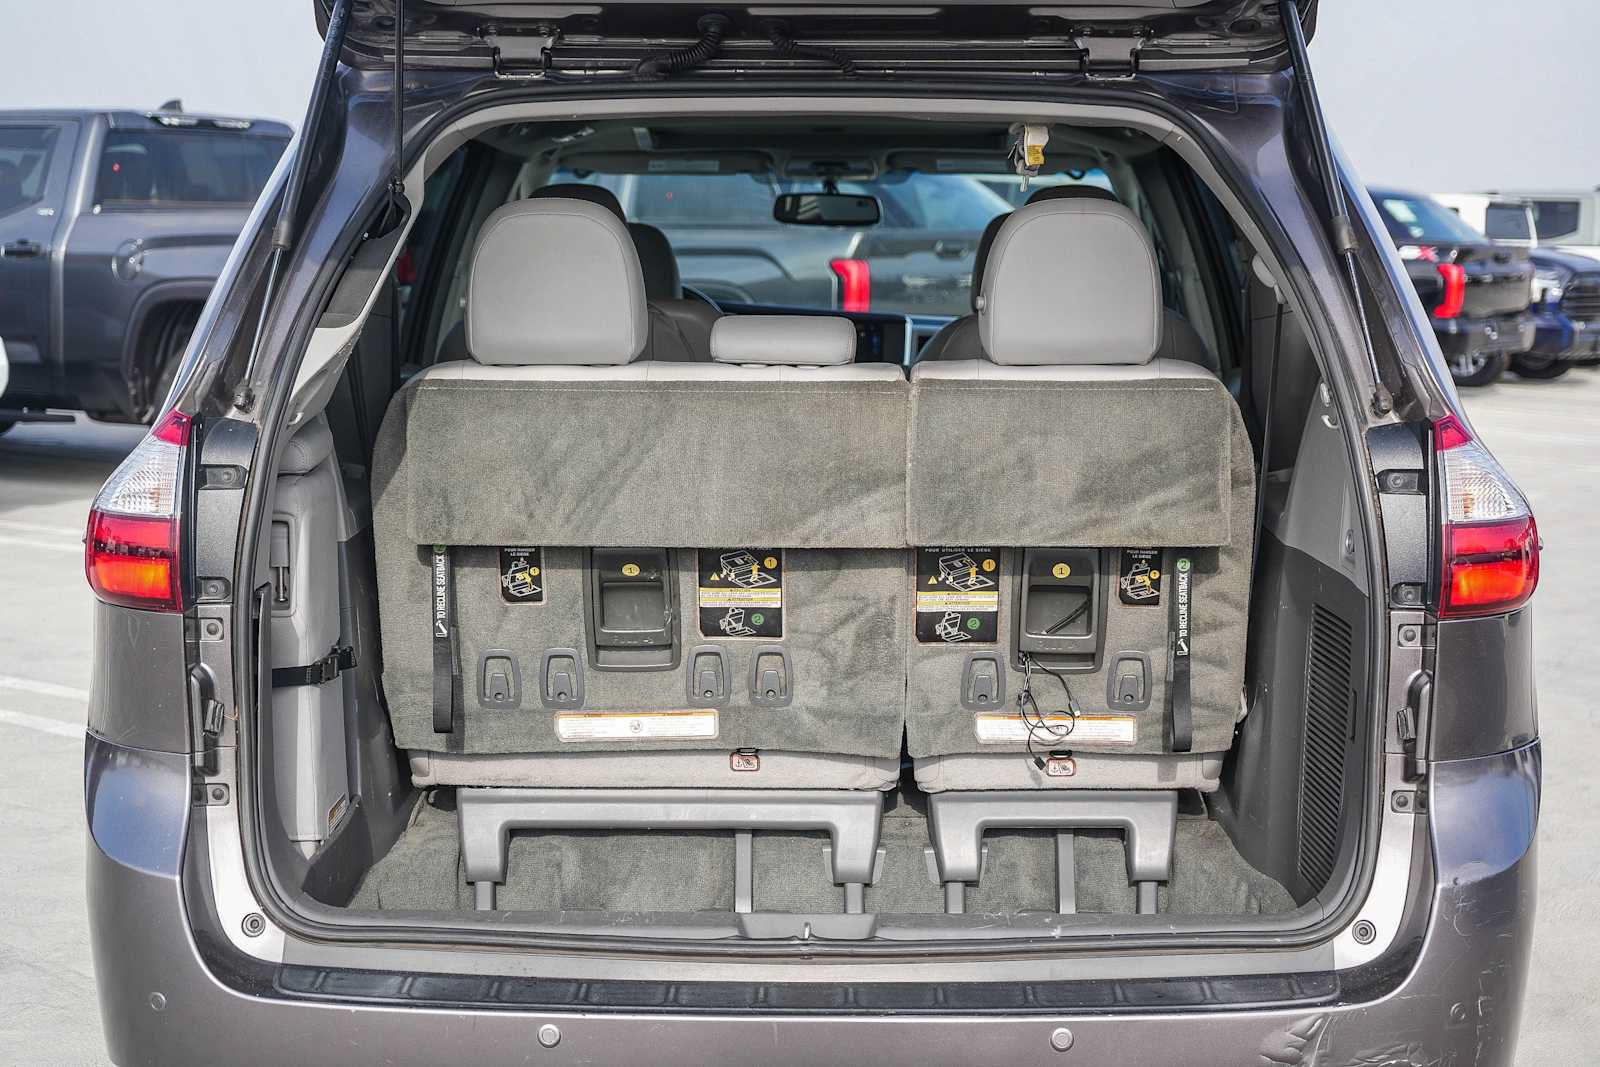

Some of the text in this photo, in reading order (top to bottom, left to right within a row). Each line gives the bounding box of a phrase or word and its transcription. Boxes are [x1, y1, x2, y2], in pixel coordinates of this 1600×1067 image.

[436, 554, 446, 586] SEATBACK
[436, 586, 446, 611] RECLINE
[1179, 573, 1188, 637] TO RECLINE SEATBACK
[436, 611, 446, 619] TO
